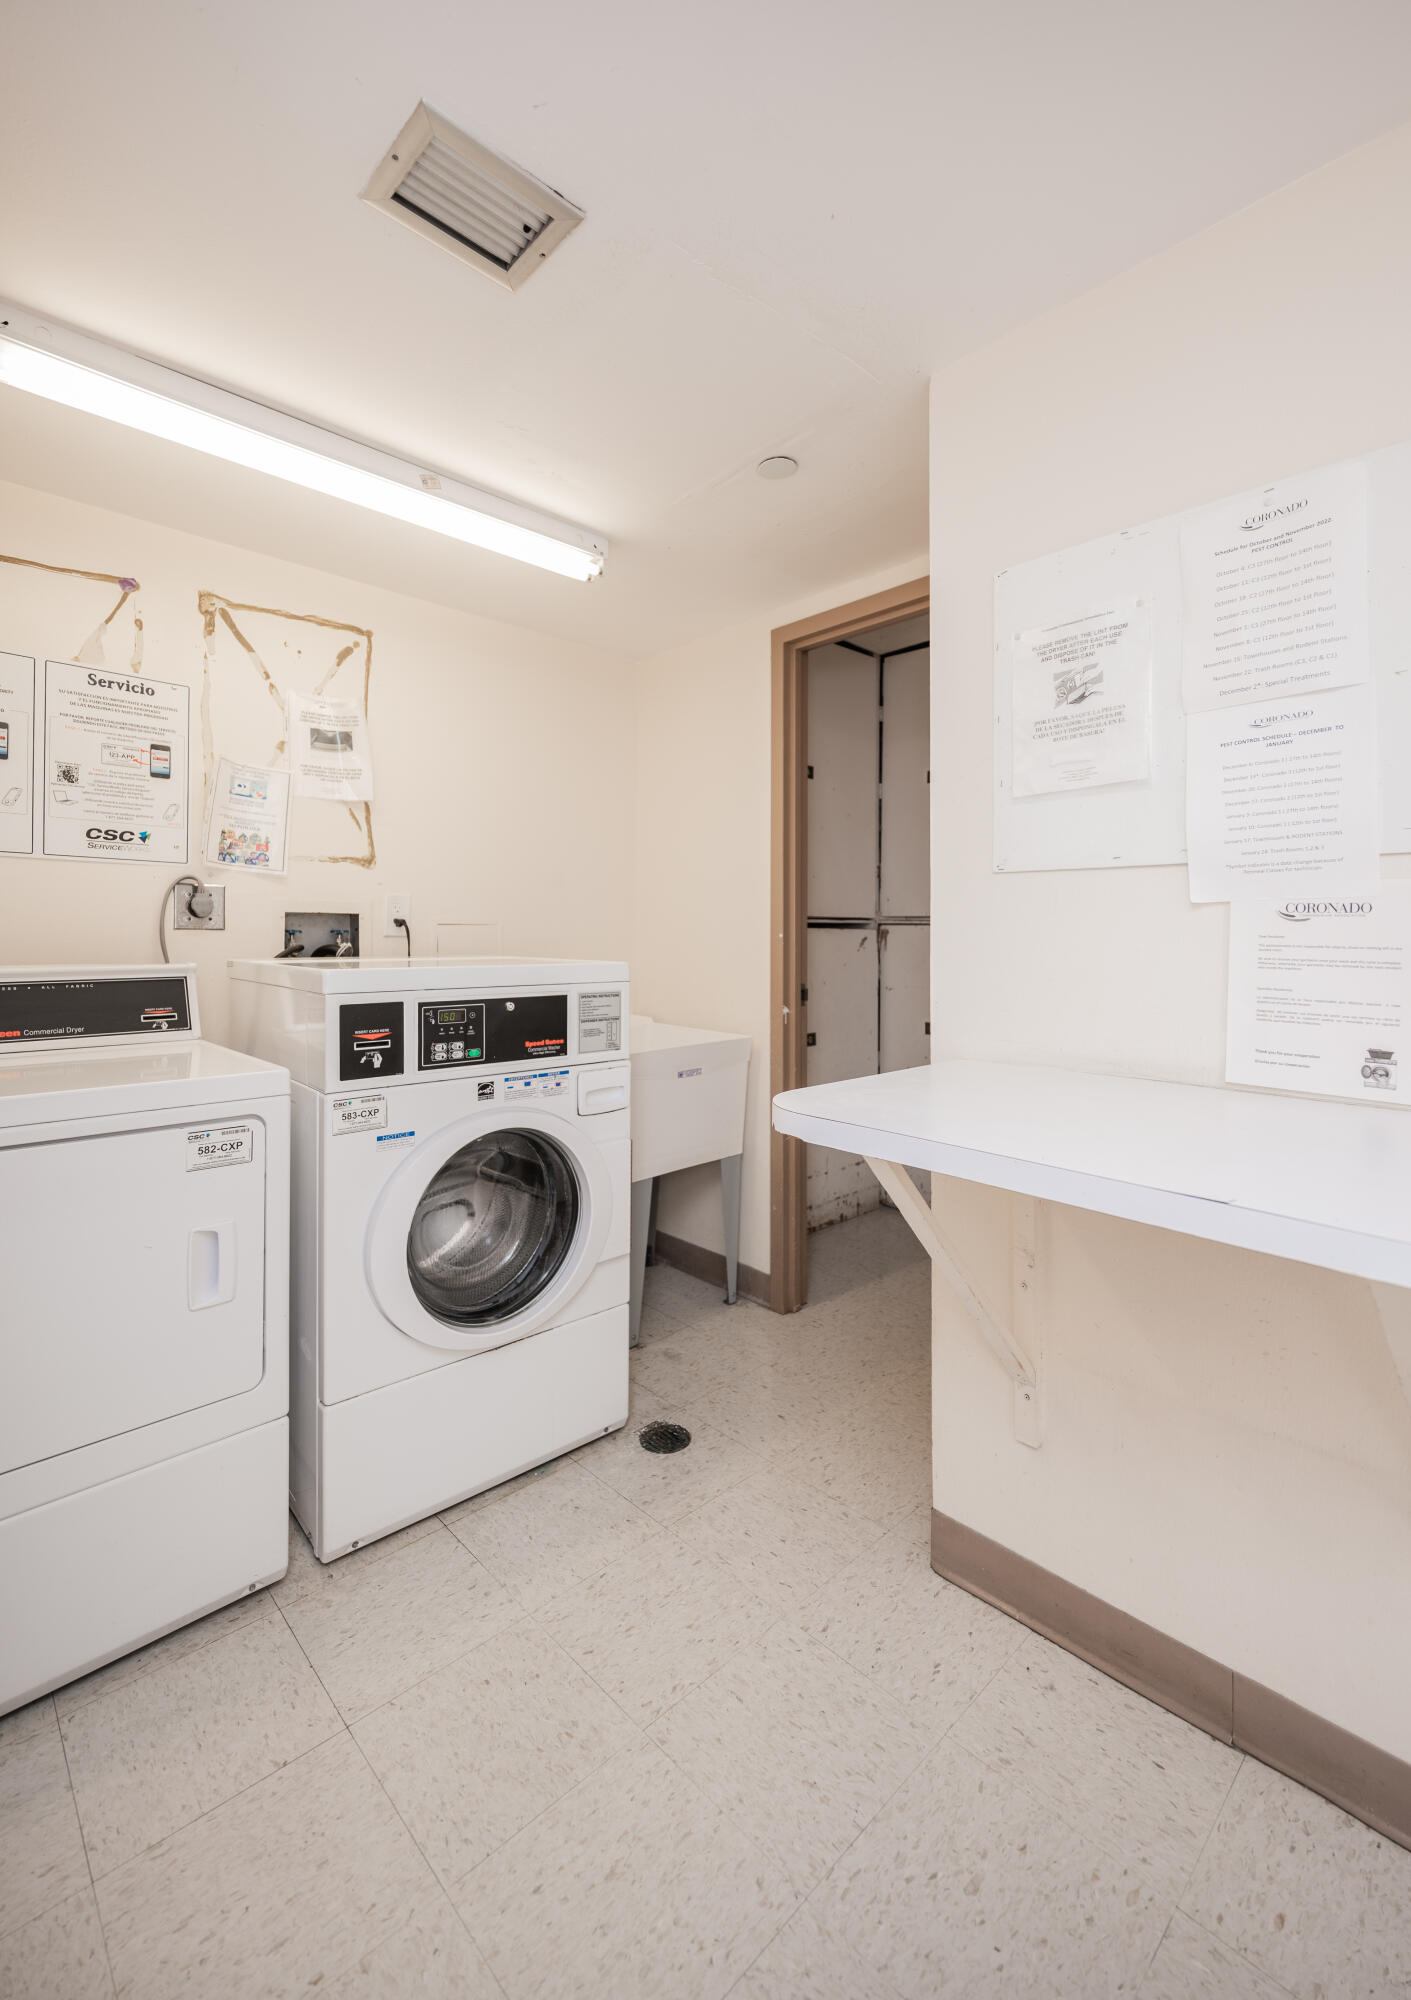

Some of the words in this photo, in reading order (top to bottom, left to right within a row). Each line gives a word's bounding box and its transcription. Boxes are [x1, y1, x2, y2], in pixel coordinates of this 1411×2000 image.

[1244, 498, 1309, 525] CORONADO
[1214, 545, 1238, 557] Schedule
[1239, 542, 1248, 550] for
[1249, 536, 1271, 548] October
[1284, 522, 1314, 538] November
[1316, 516, 1332, 527] 2022
[1266, 537, 1292, 550] CONTROL
[1110, 622, 1128, 632] FROM
[1036, 650, 1047, 658] THE
[1049, 644, 1067, 654] DRYER
[1090, 634, 1108, 643] EACH
[1053, 649, 1078, 660] DISPOSE
[1060, 655, 1078, 664] TRASH
[87, 673, 156, 697] Servicio
[1219, 684, 1250, 697] December
[1264, 677, 1288, 687] Special
[1289, 669, 1330, 683] Treatments
[1253, 710, 1315, 725] CORONADO
[1234, 736, 1260, 746] CONTROL
[1262, 732, 1291, 742] SCHEDULE
[1298, 726, 1331, 736] DECEMBER
[1265, 738, 1293, 748] JANUARY
[86, 828, 135, 842] CSC
[1285, 902, 1373, 914] CORONADO
[23, 1027, 65, 1037] Commercial
[66, 1025, 84, 1037] Dryer
[525, 1039, 545, 1048] Speed
[342, 1108, 379, 1121] 583-CXP
[198, 1141, 243, 1156] 582-CXP
